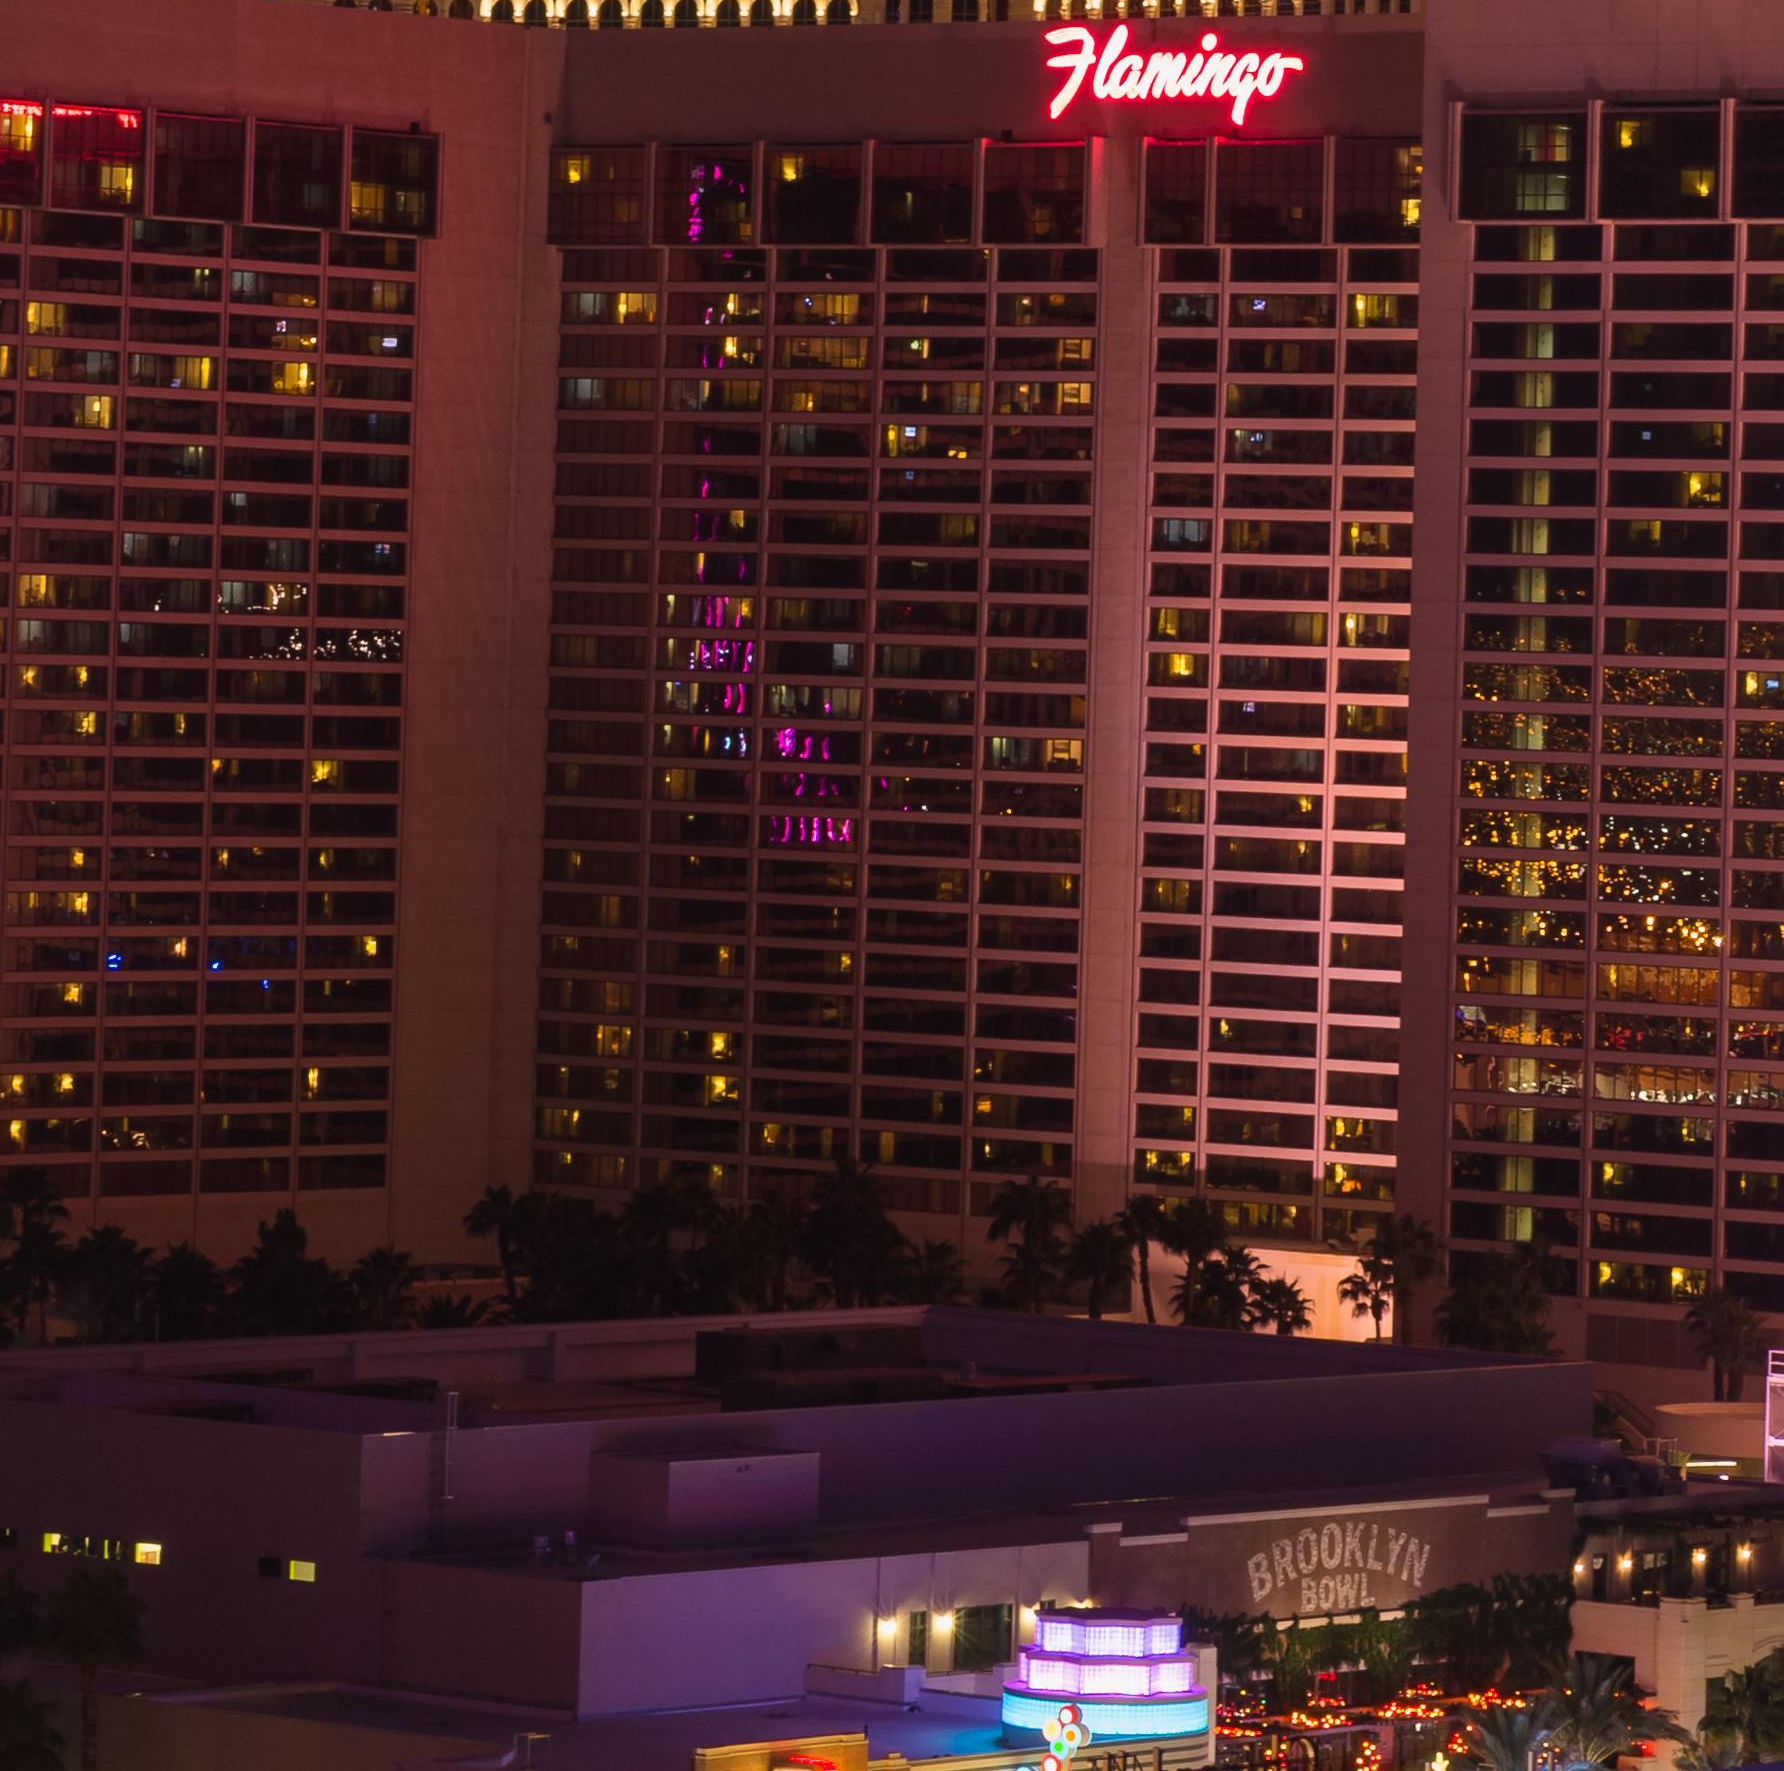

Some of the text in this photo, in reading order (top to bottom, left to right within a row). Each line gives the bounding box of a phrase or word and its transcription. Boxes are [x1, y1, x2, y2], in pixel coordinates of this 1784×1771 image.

[1043, 24, 1304, 126] Flamingo
[1246, 1521, 1431, 1603] BROOKLYN
[1300, 1572, 1377, 1613] BOWL
